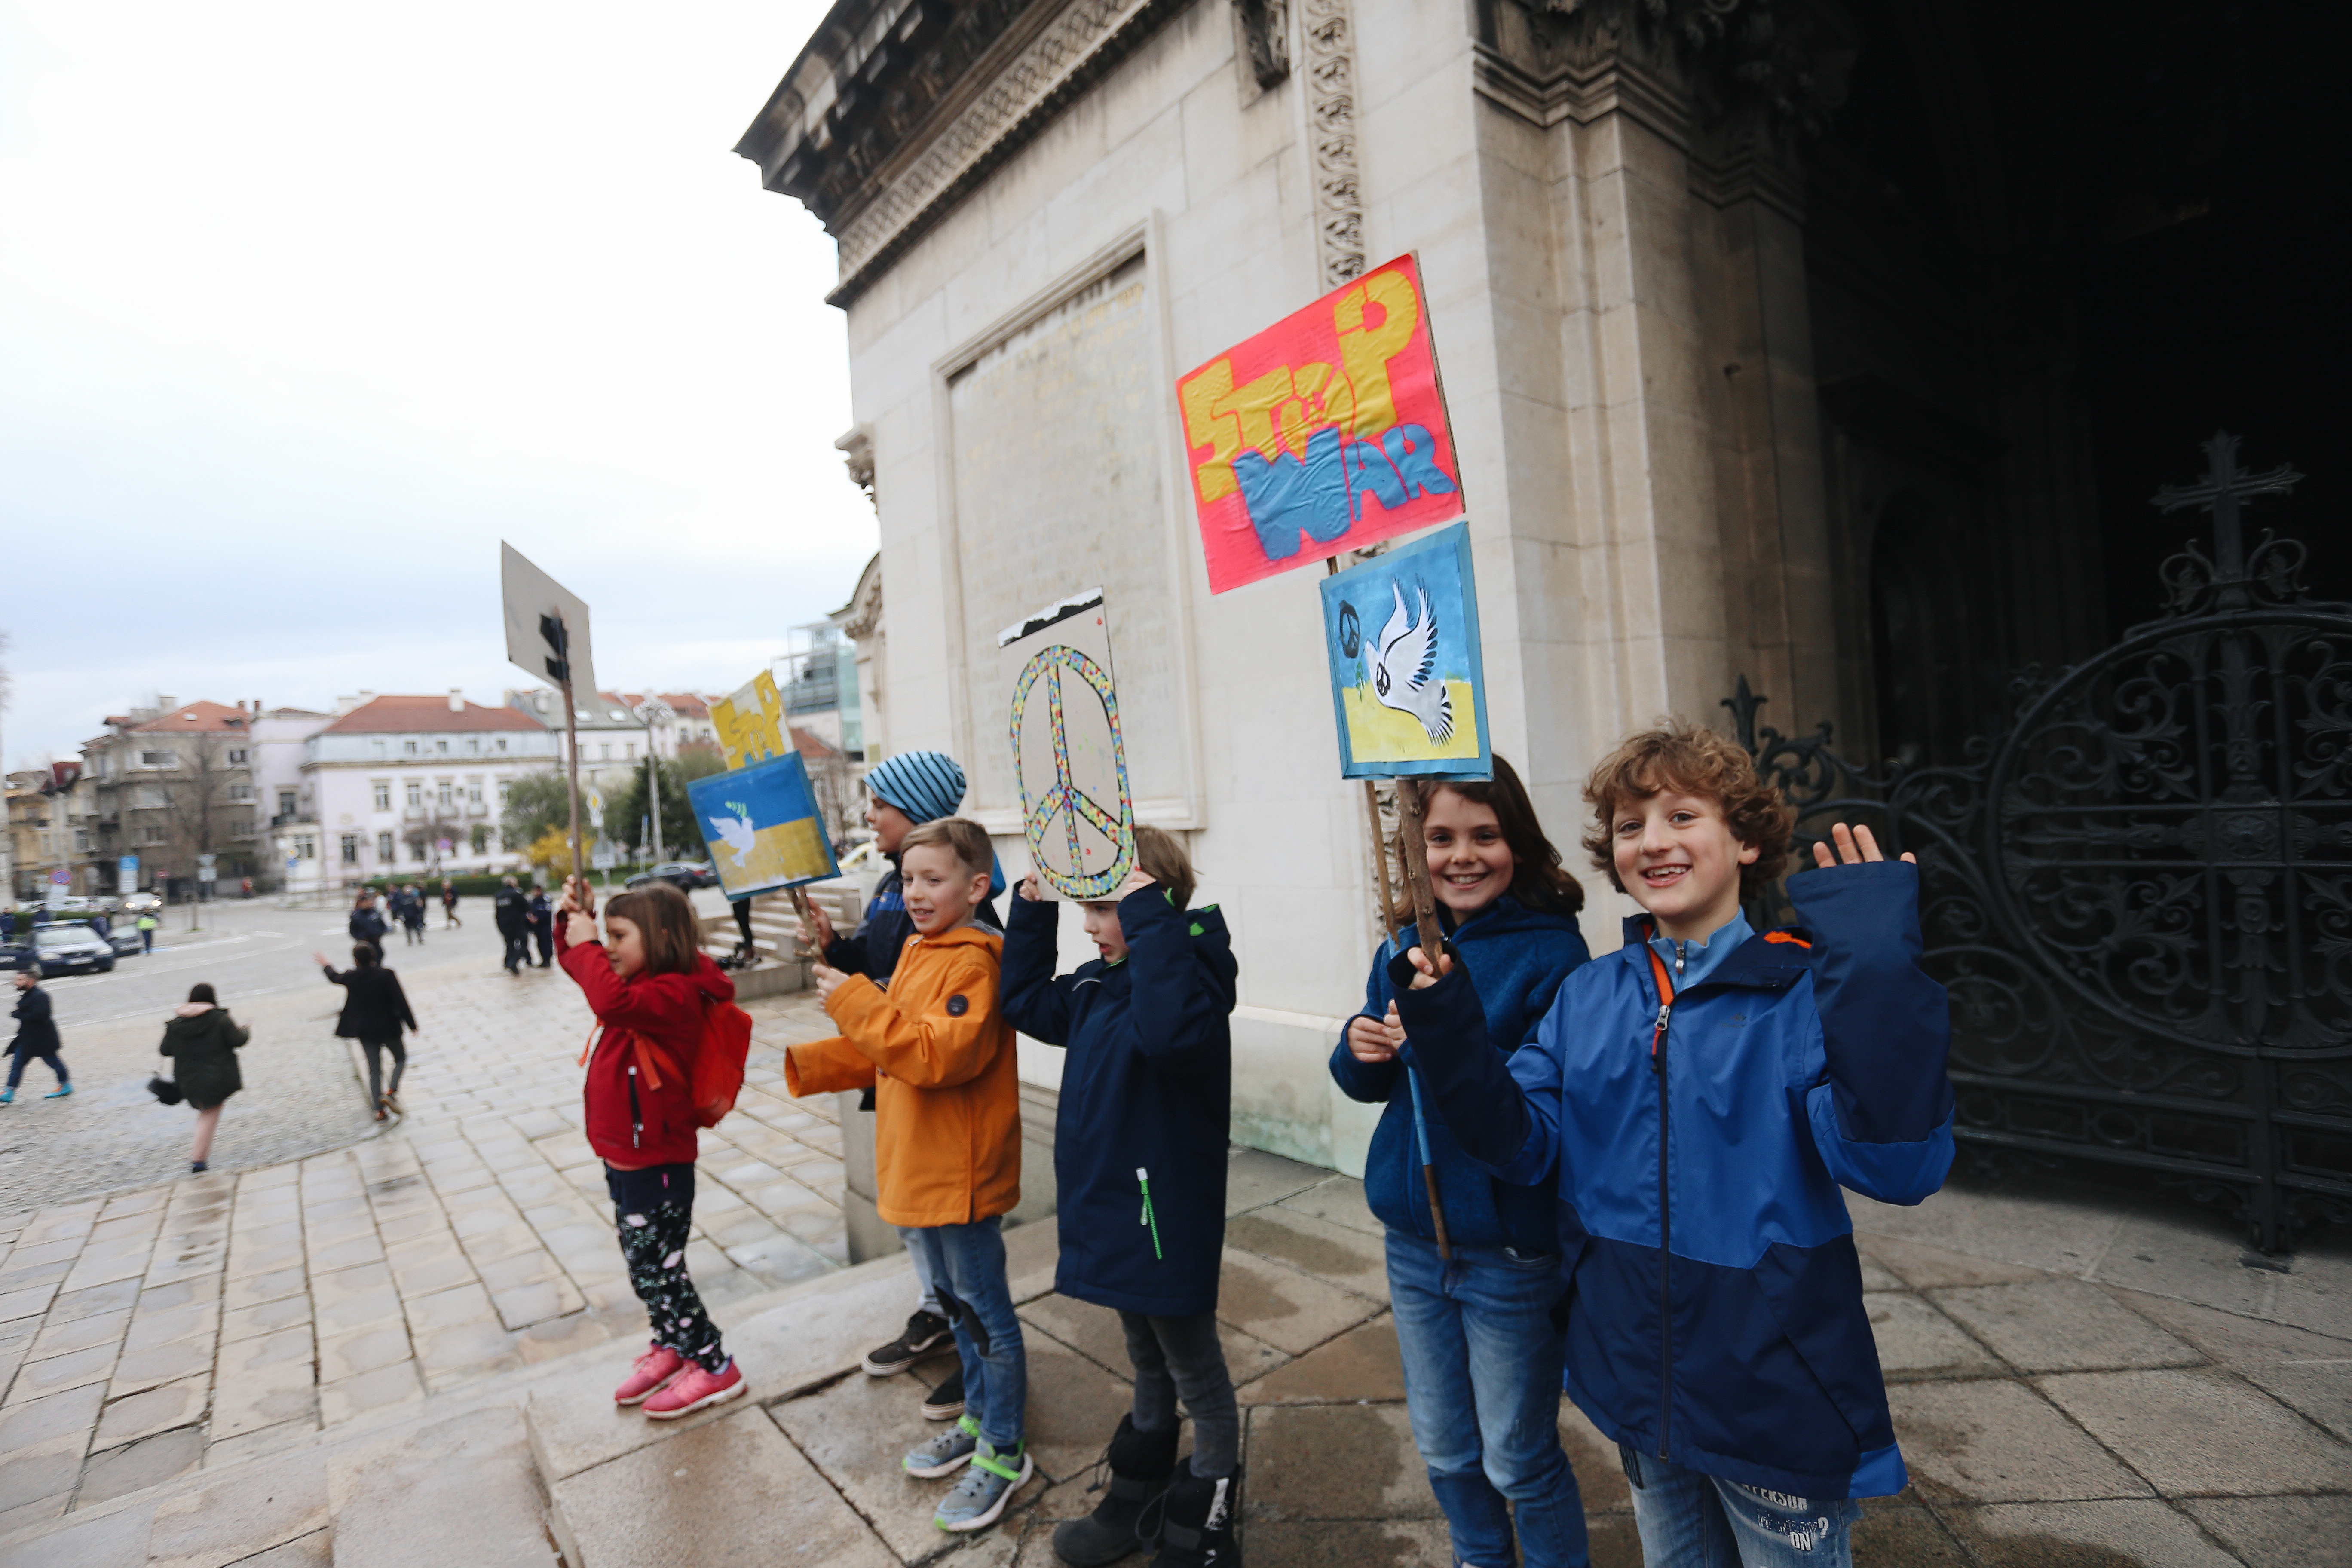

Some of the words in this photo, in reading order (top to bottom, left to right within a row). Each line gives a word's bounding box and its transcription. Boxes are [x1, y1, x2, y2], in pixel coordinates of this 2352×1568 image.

[1182, 269, 1418, 503] STOP
[1230, 423, 1458, 561] WAR
[1789, 1531, 1812, 1551] ON
